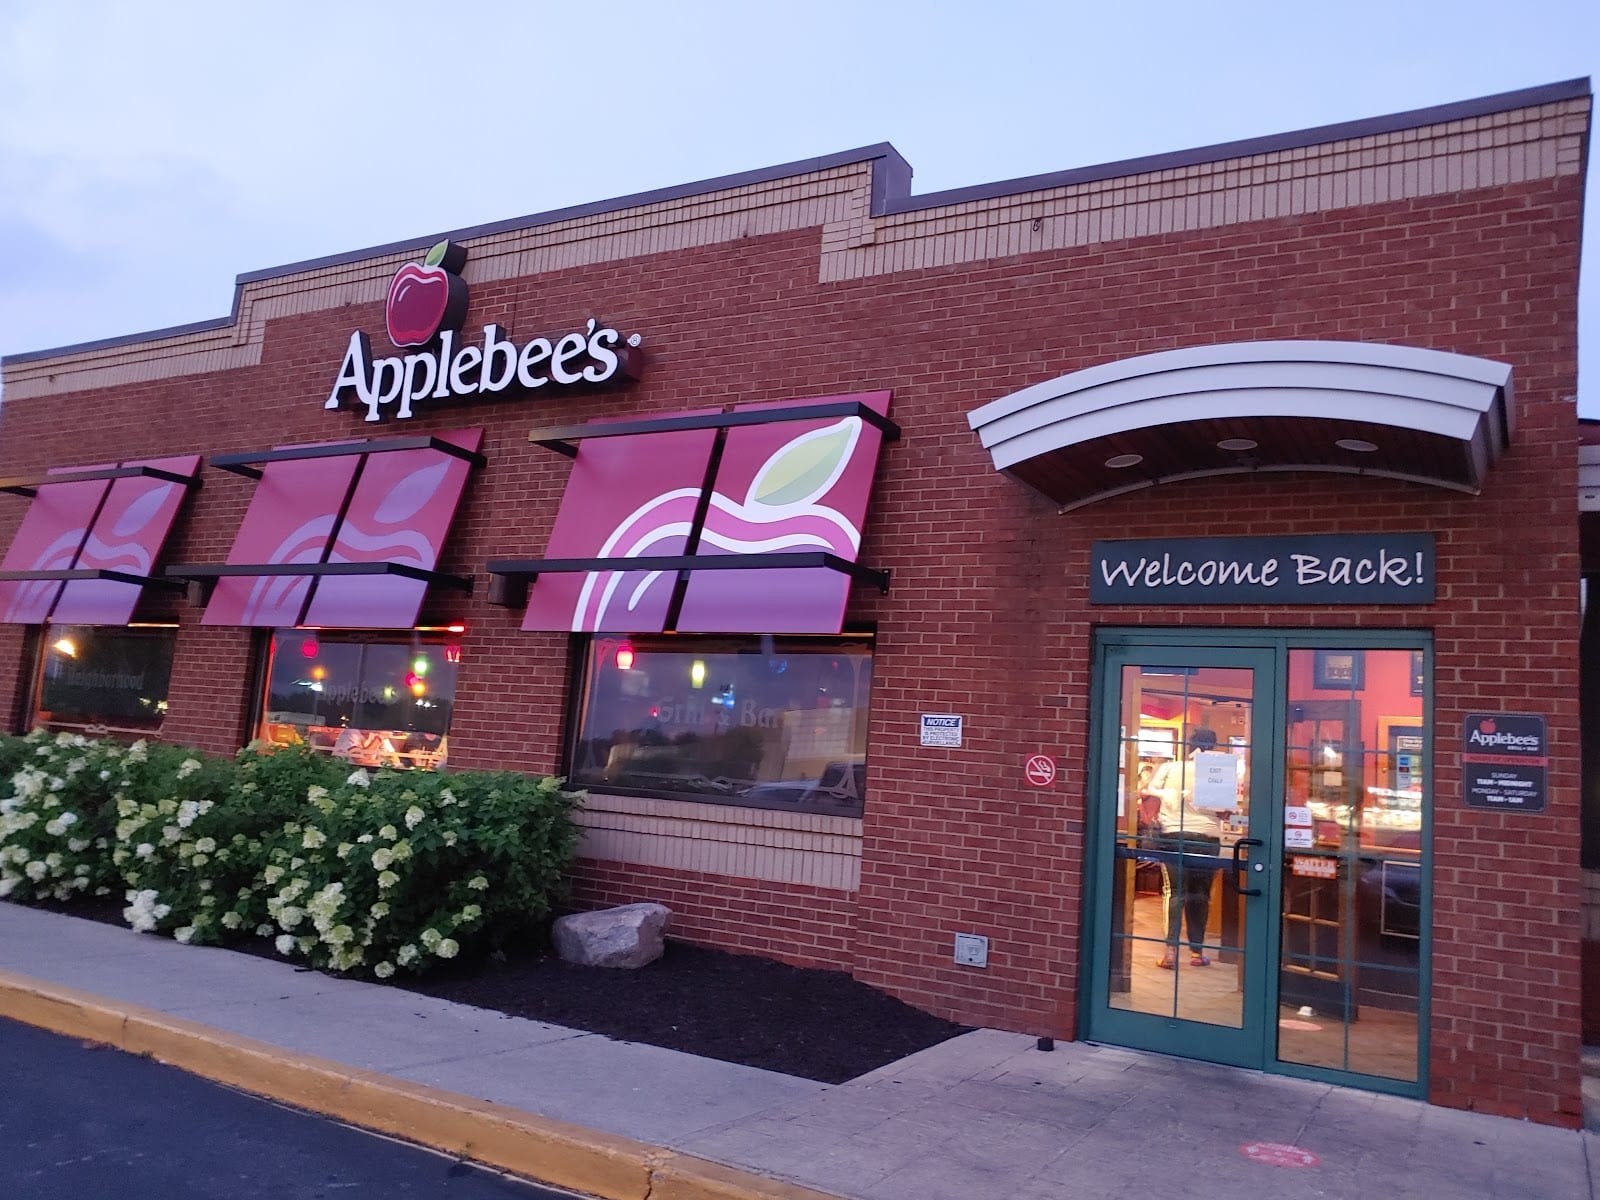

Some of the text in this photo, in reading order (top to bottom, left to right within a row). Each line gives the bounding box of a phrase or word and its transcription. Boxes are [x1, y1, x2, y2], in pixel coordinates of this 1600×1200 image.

[324, 317, 620, 422] Applebee's
[1100, 549, 1425, 587] Welcome Back!
[926, 718, 957, 727] NOTICE
[1469, 729, 1540, 747] Applebee's
